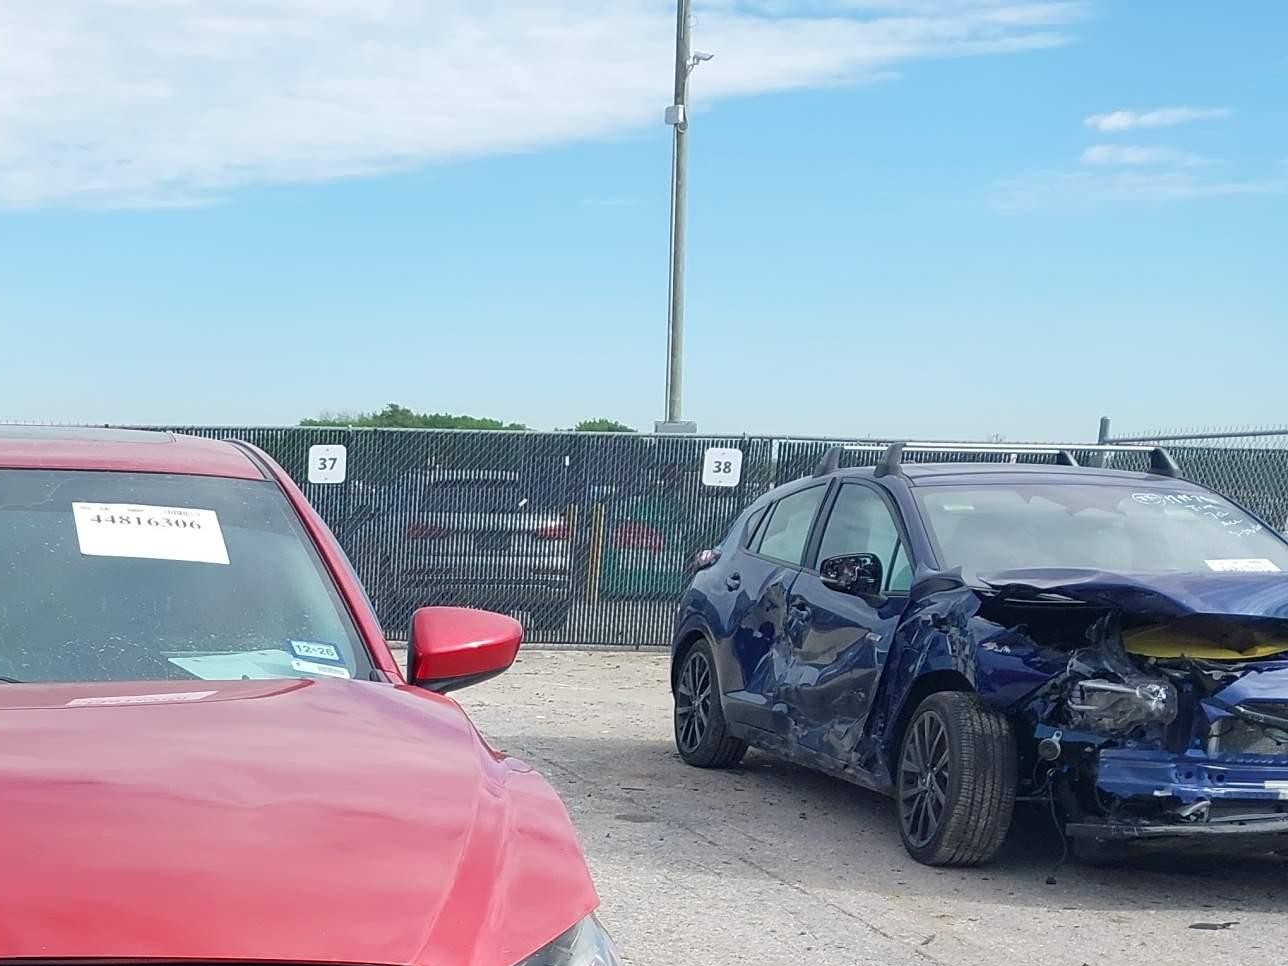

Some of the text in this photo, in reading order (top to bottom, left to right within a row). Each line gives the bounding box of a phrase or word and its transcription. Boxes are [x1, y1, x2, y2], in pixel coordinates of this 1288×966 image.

[318, 457, 338, 471] 37
[712, 460, 733, 474] 38
[89, 513, 203, 531] 44816306
